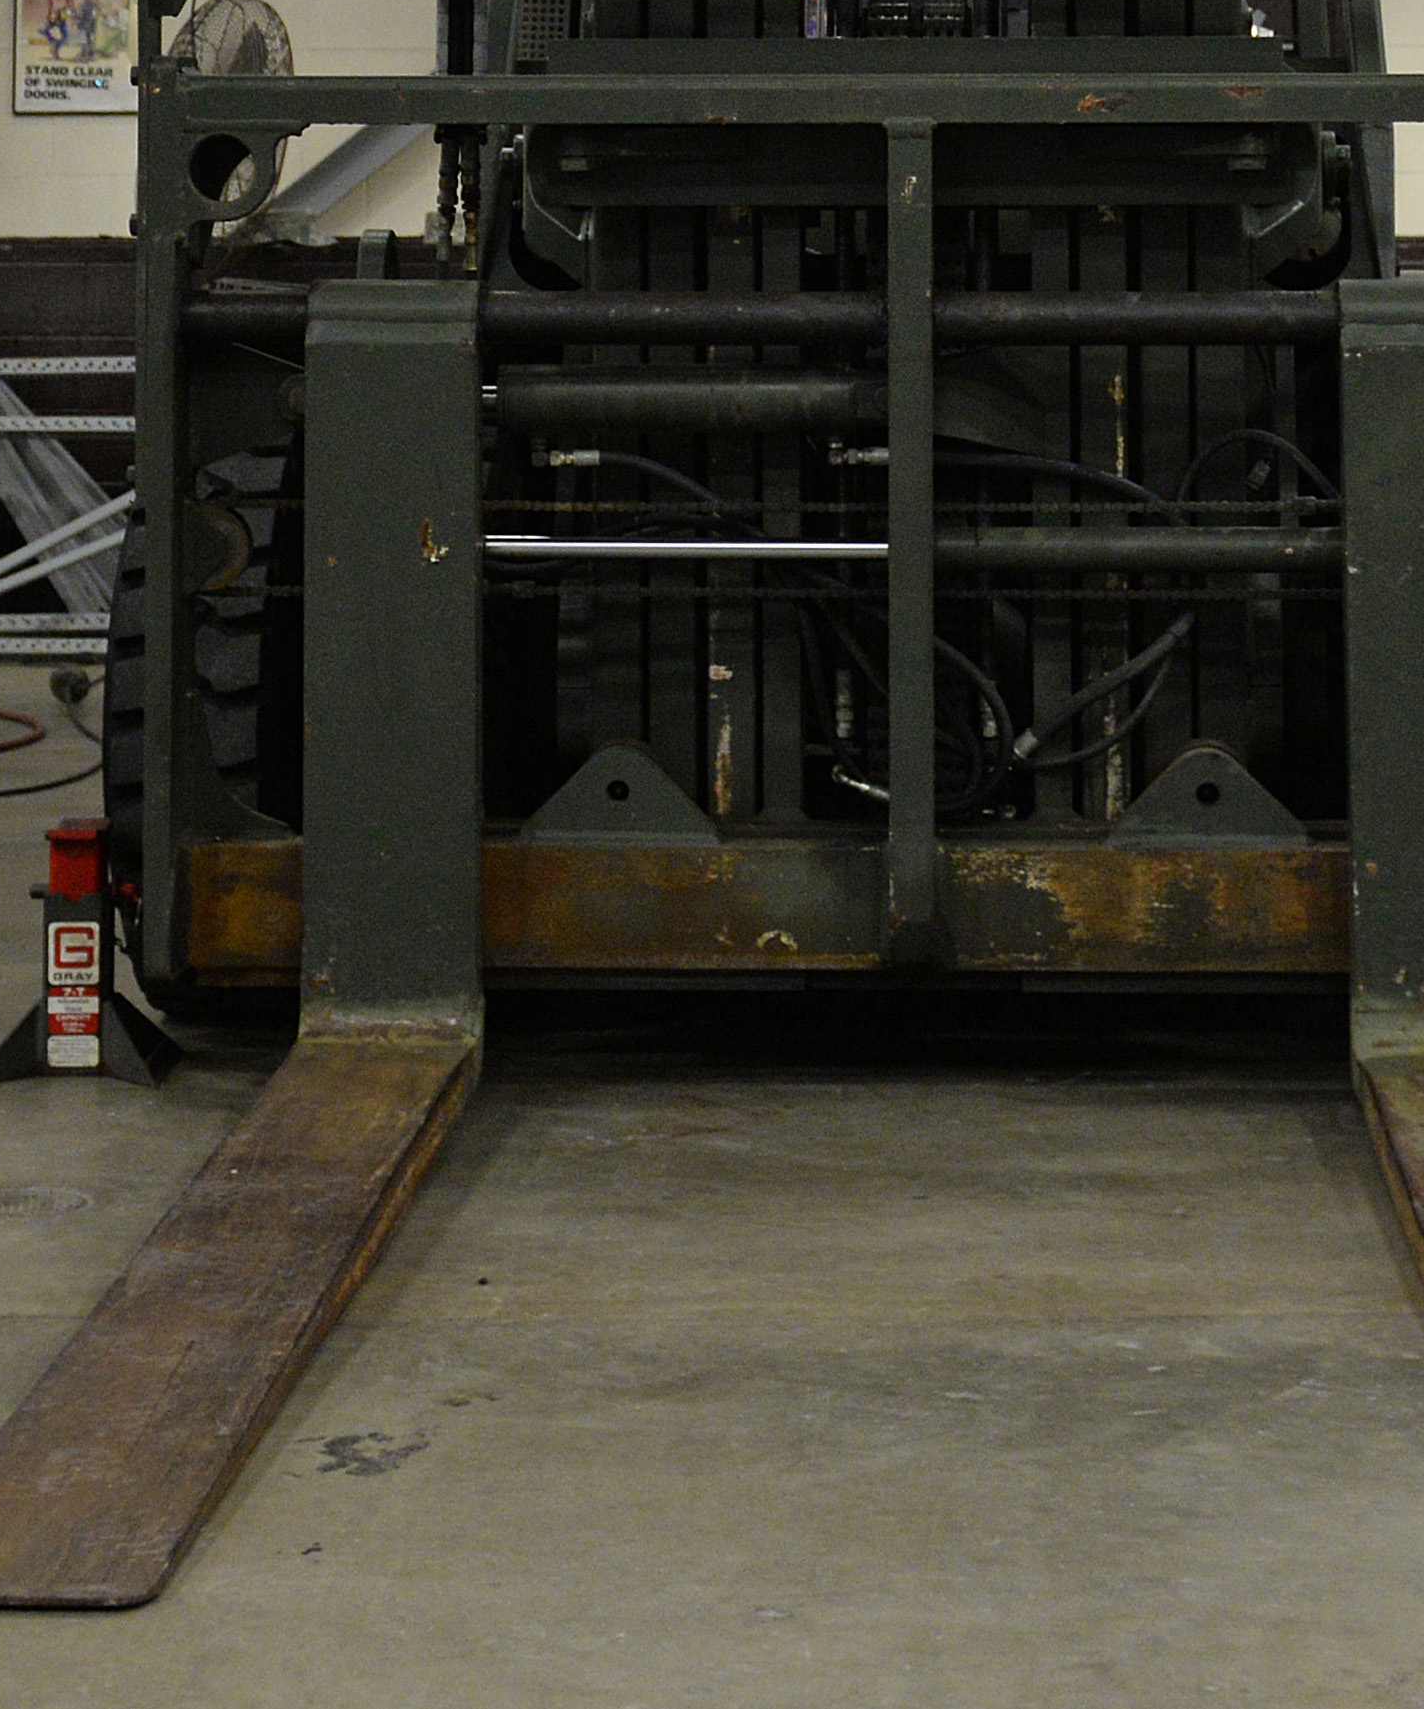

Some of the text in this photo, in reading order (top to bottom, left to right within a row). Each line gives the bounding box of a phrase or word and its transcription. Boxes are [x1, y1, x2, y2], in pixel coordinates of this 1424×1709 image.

[25, 65, 113, 77] STAND CLEAR
[24, 77, 40, 87] OF
[24, 89, 71, 100] DOORS.
[54, 927, 94, 968] G
[53, 972, 94, 981] GRAY
